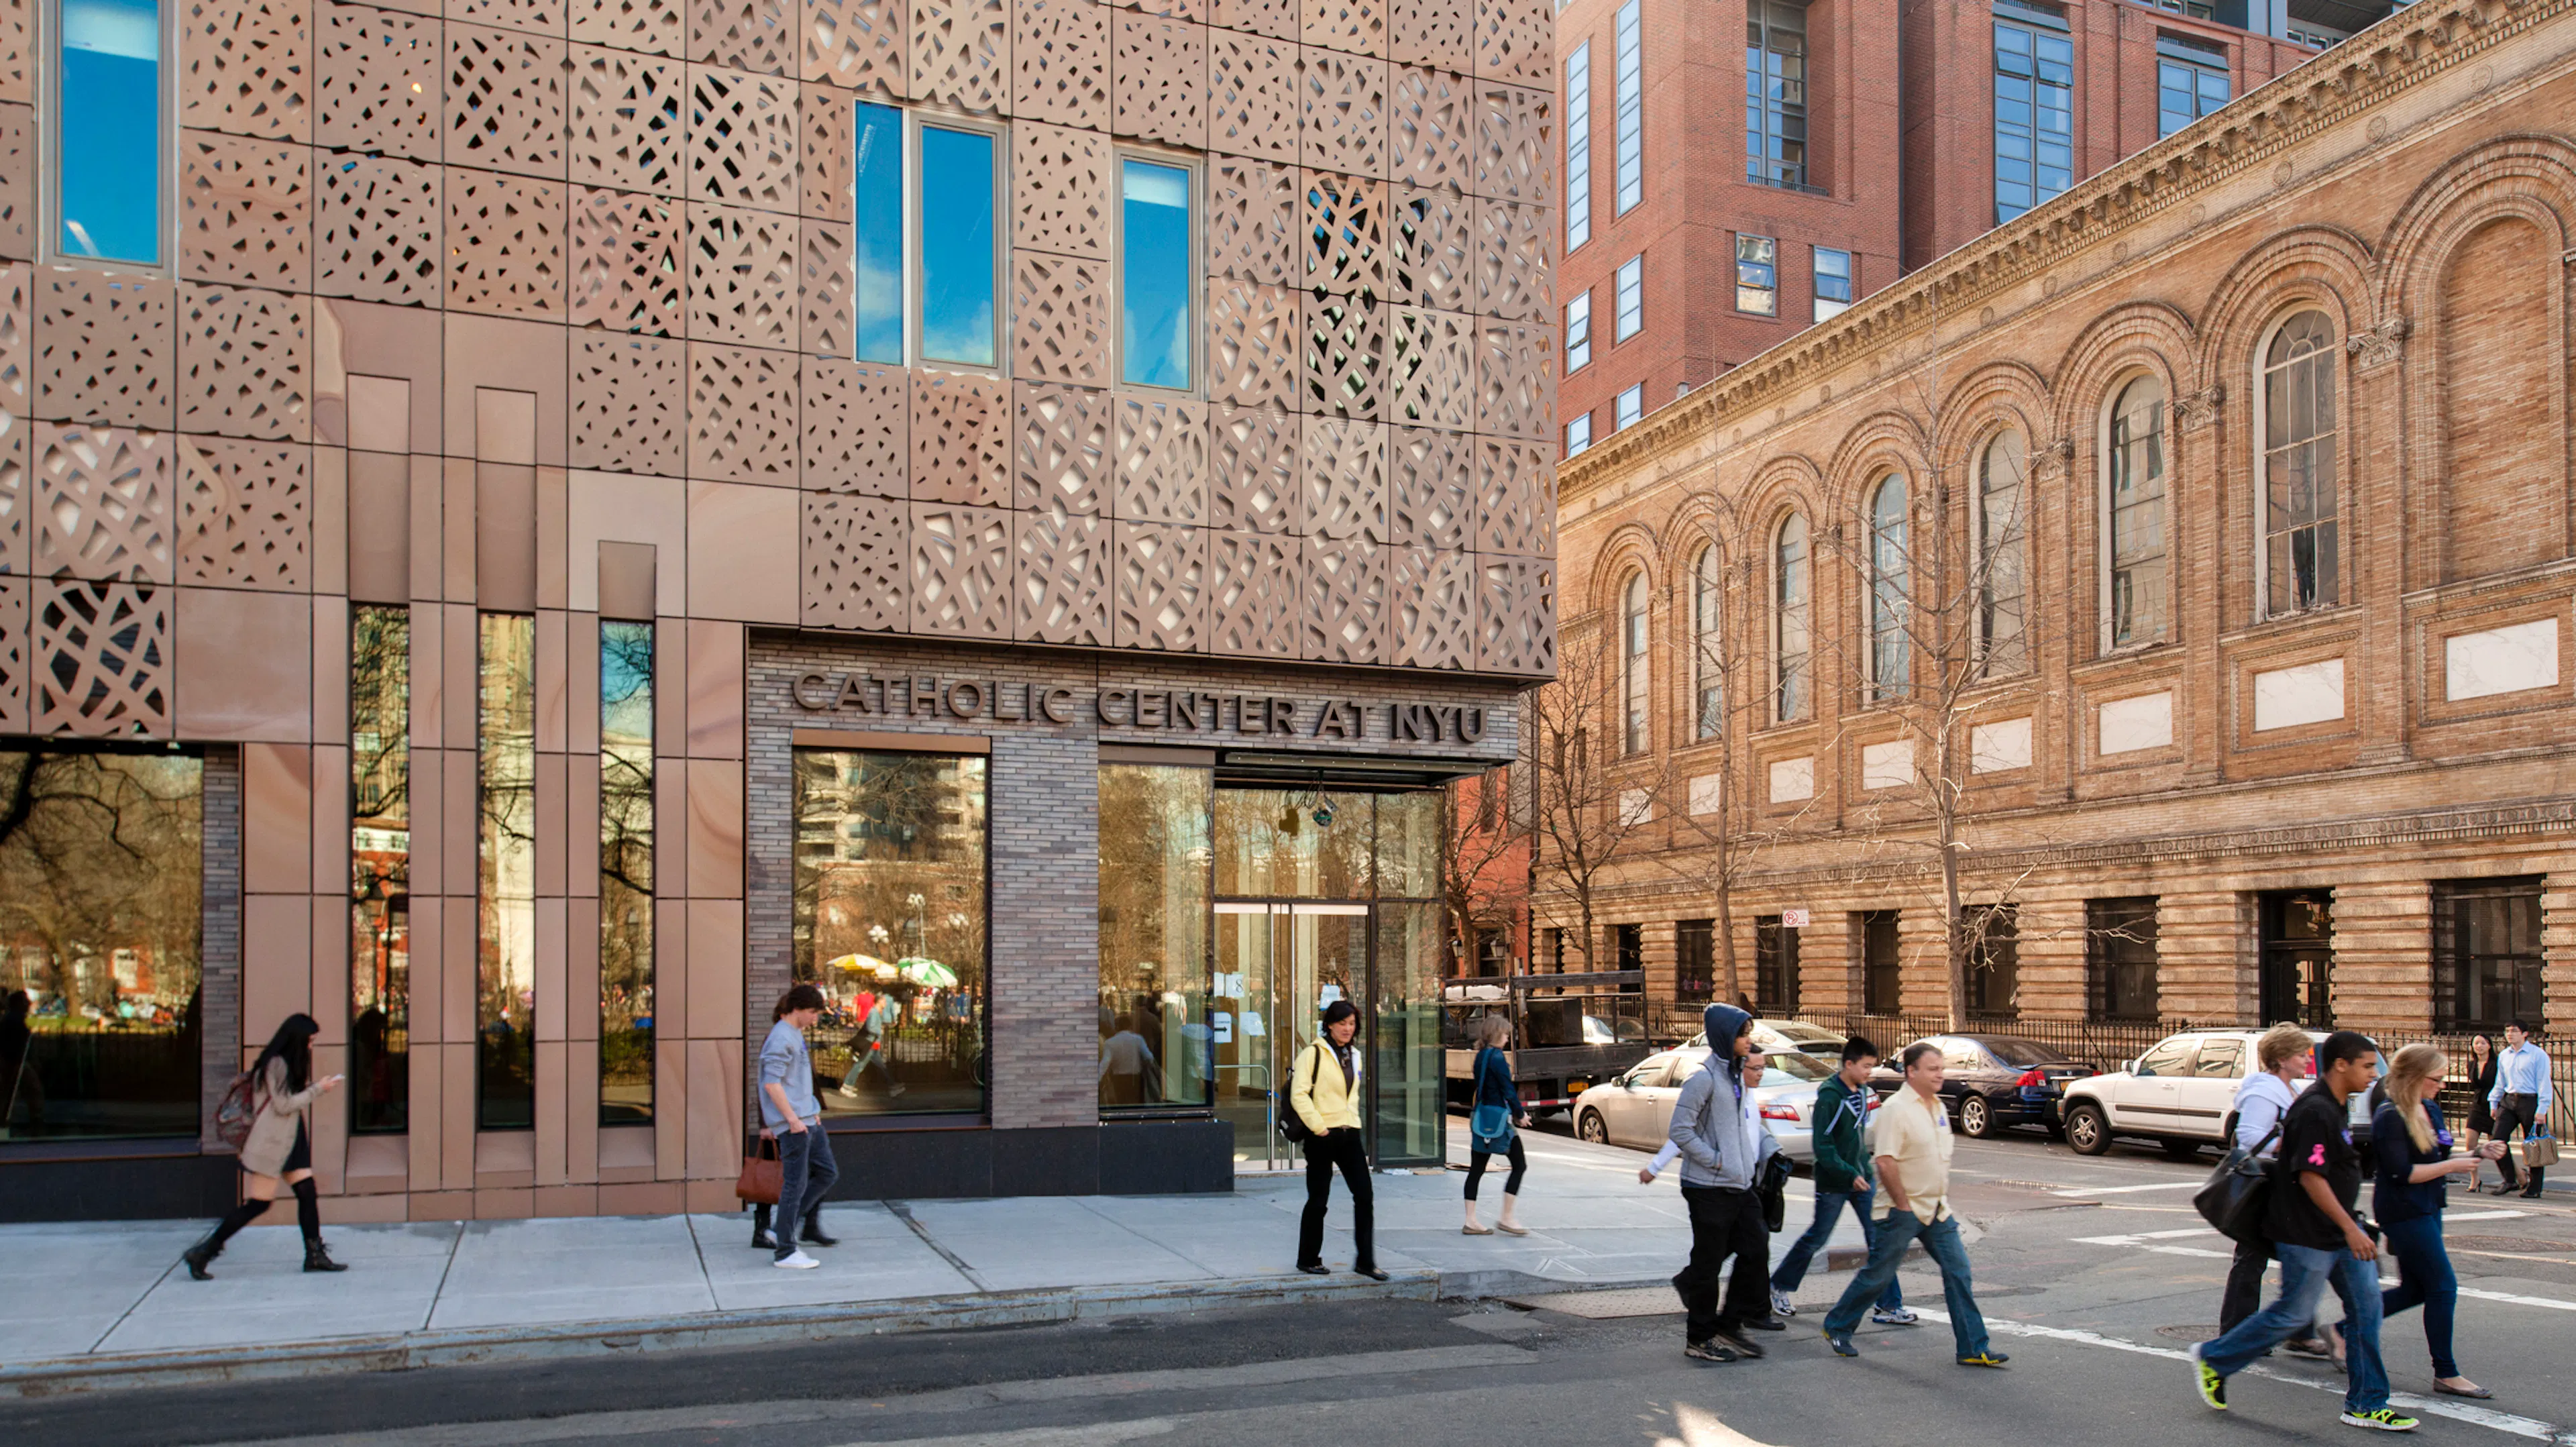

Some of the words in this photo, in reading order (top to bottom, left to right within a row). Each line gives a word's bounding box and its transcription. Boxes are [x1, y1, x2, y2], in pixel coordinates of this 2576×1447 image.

[793, 670, 1075, 722] CATHOLIC
[1097, 686, 1299, 734] CENTER
[1315, 699, 1377, 738] AT
[1392, 702, 1488, 745] NYU
[1236, 978, 1244, 994] 8
